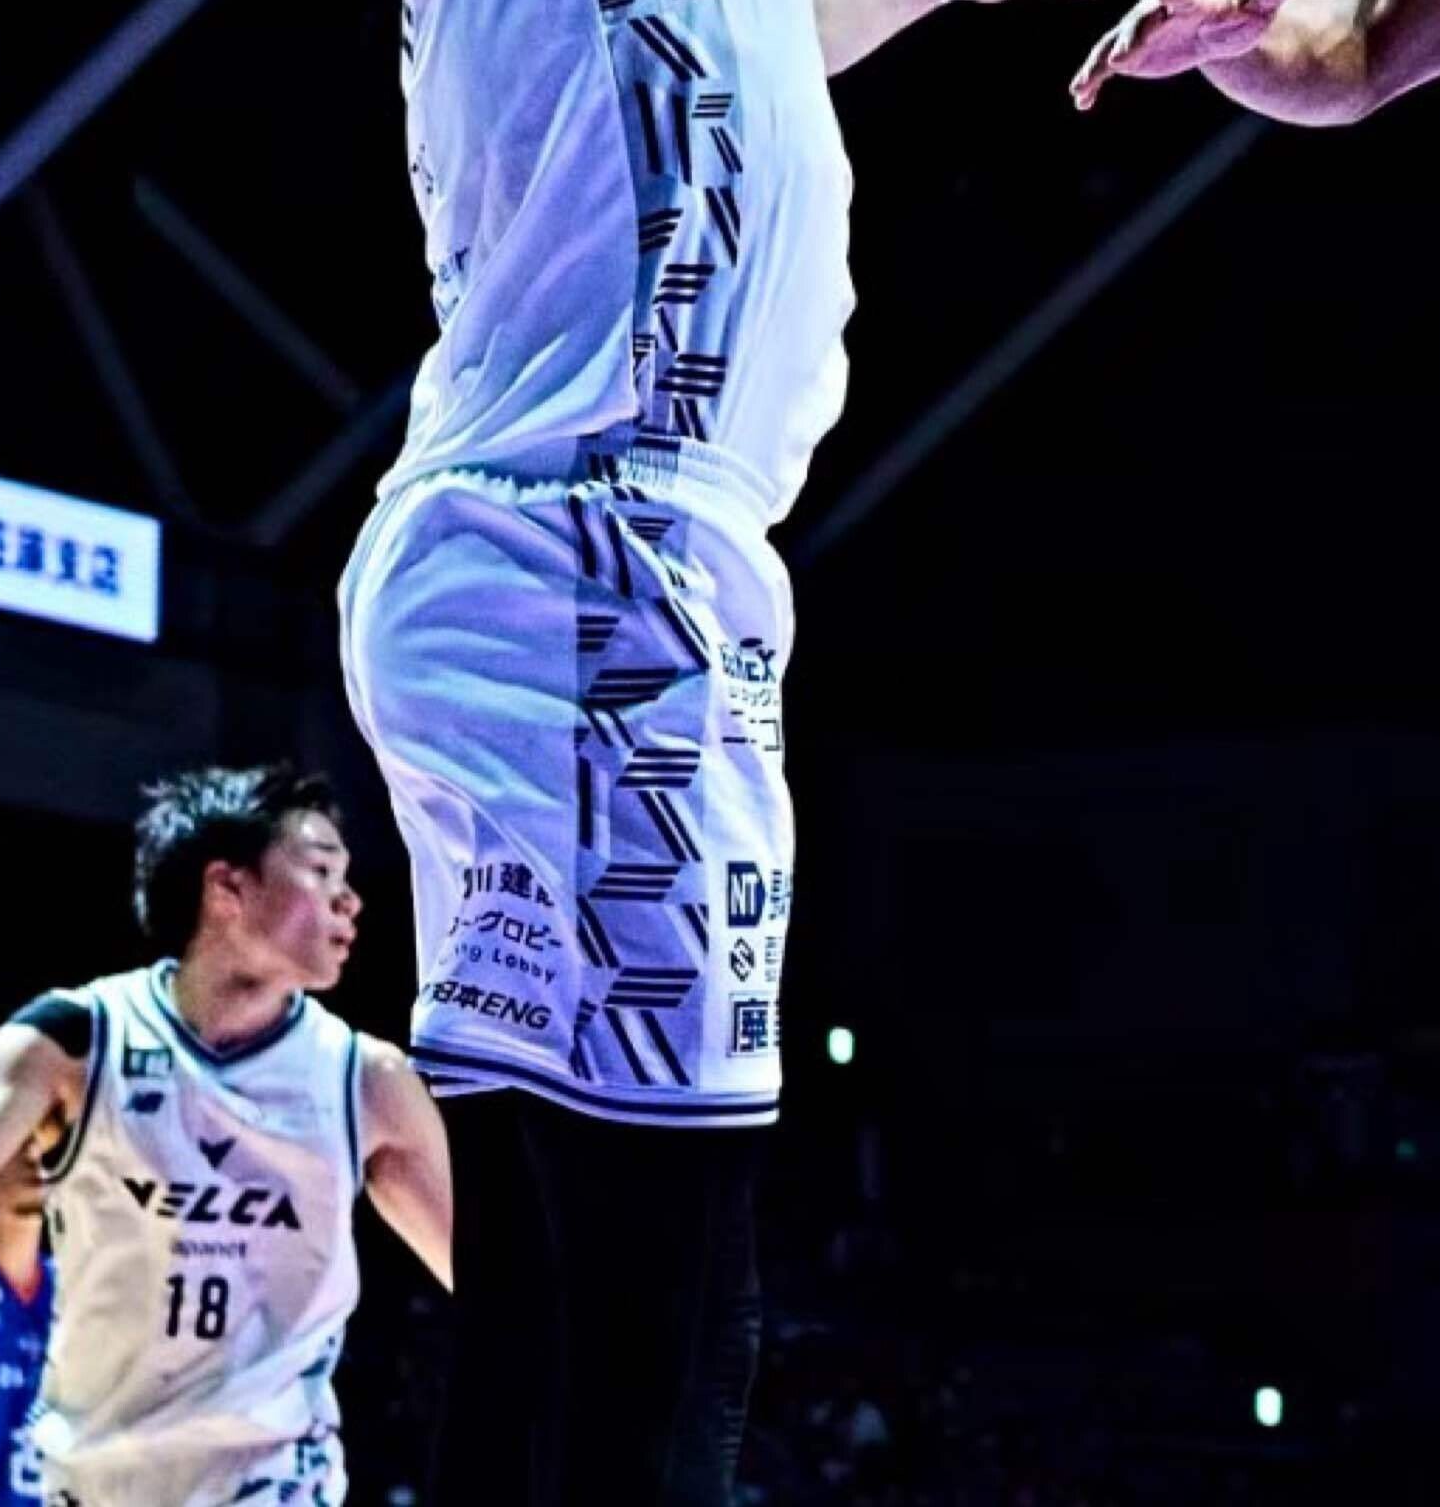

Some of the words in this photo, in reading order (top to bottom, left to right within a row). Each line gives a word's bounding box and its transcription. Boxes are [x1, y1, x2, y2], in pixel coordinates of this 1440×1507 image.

[421, 980, 552, 1030] 日本ENG
[122, 1176, 303, 1230] VELCA
[165, 1273, 229, 1339] 18
